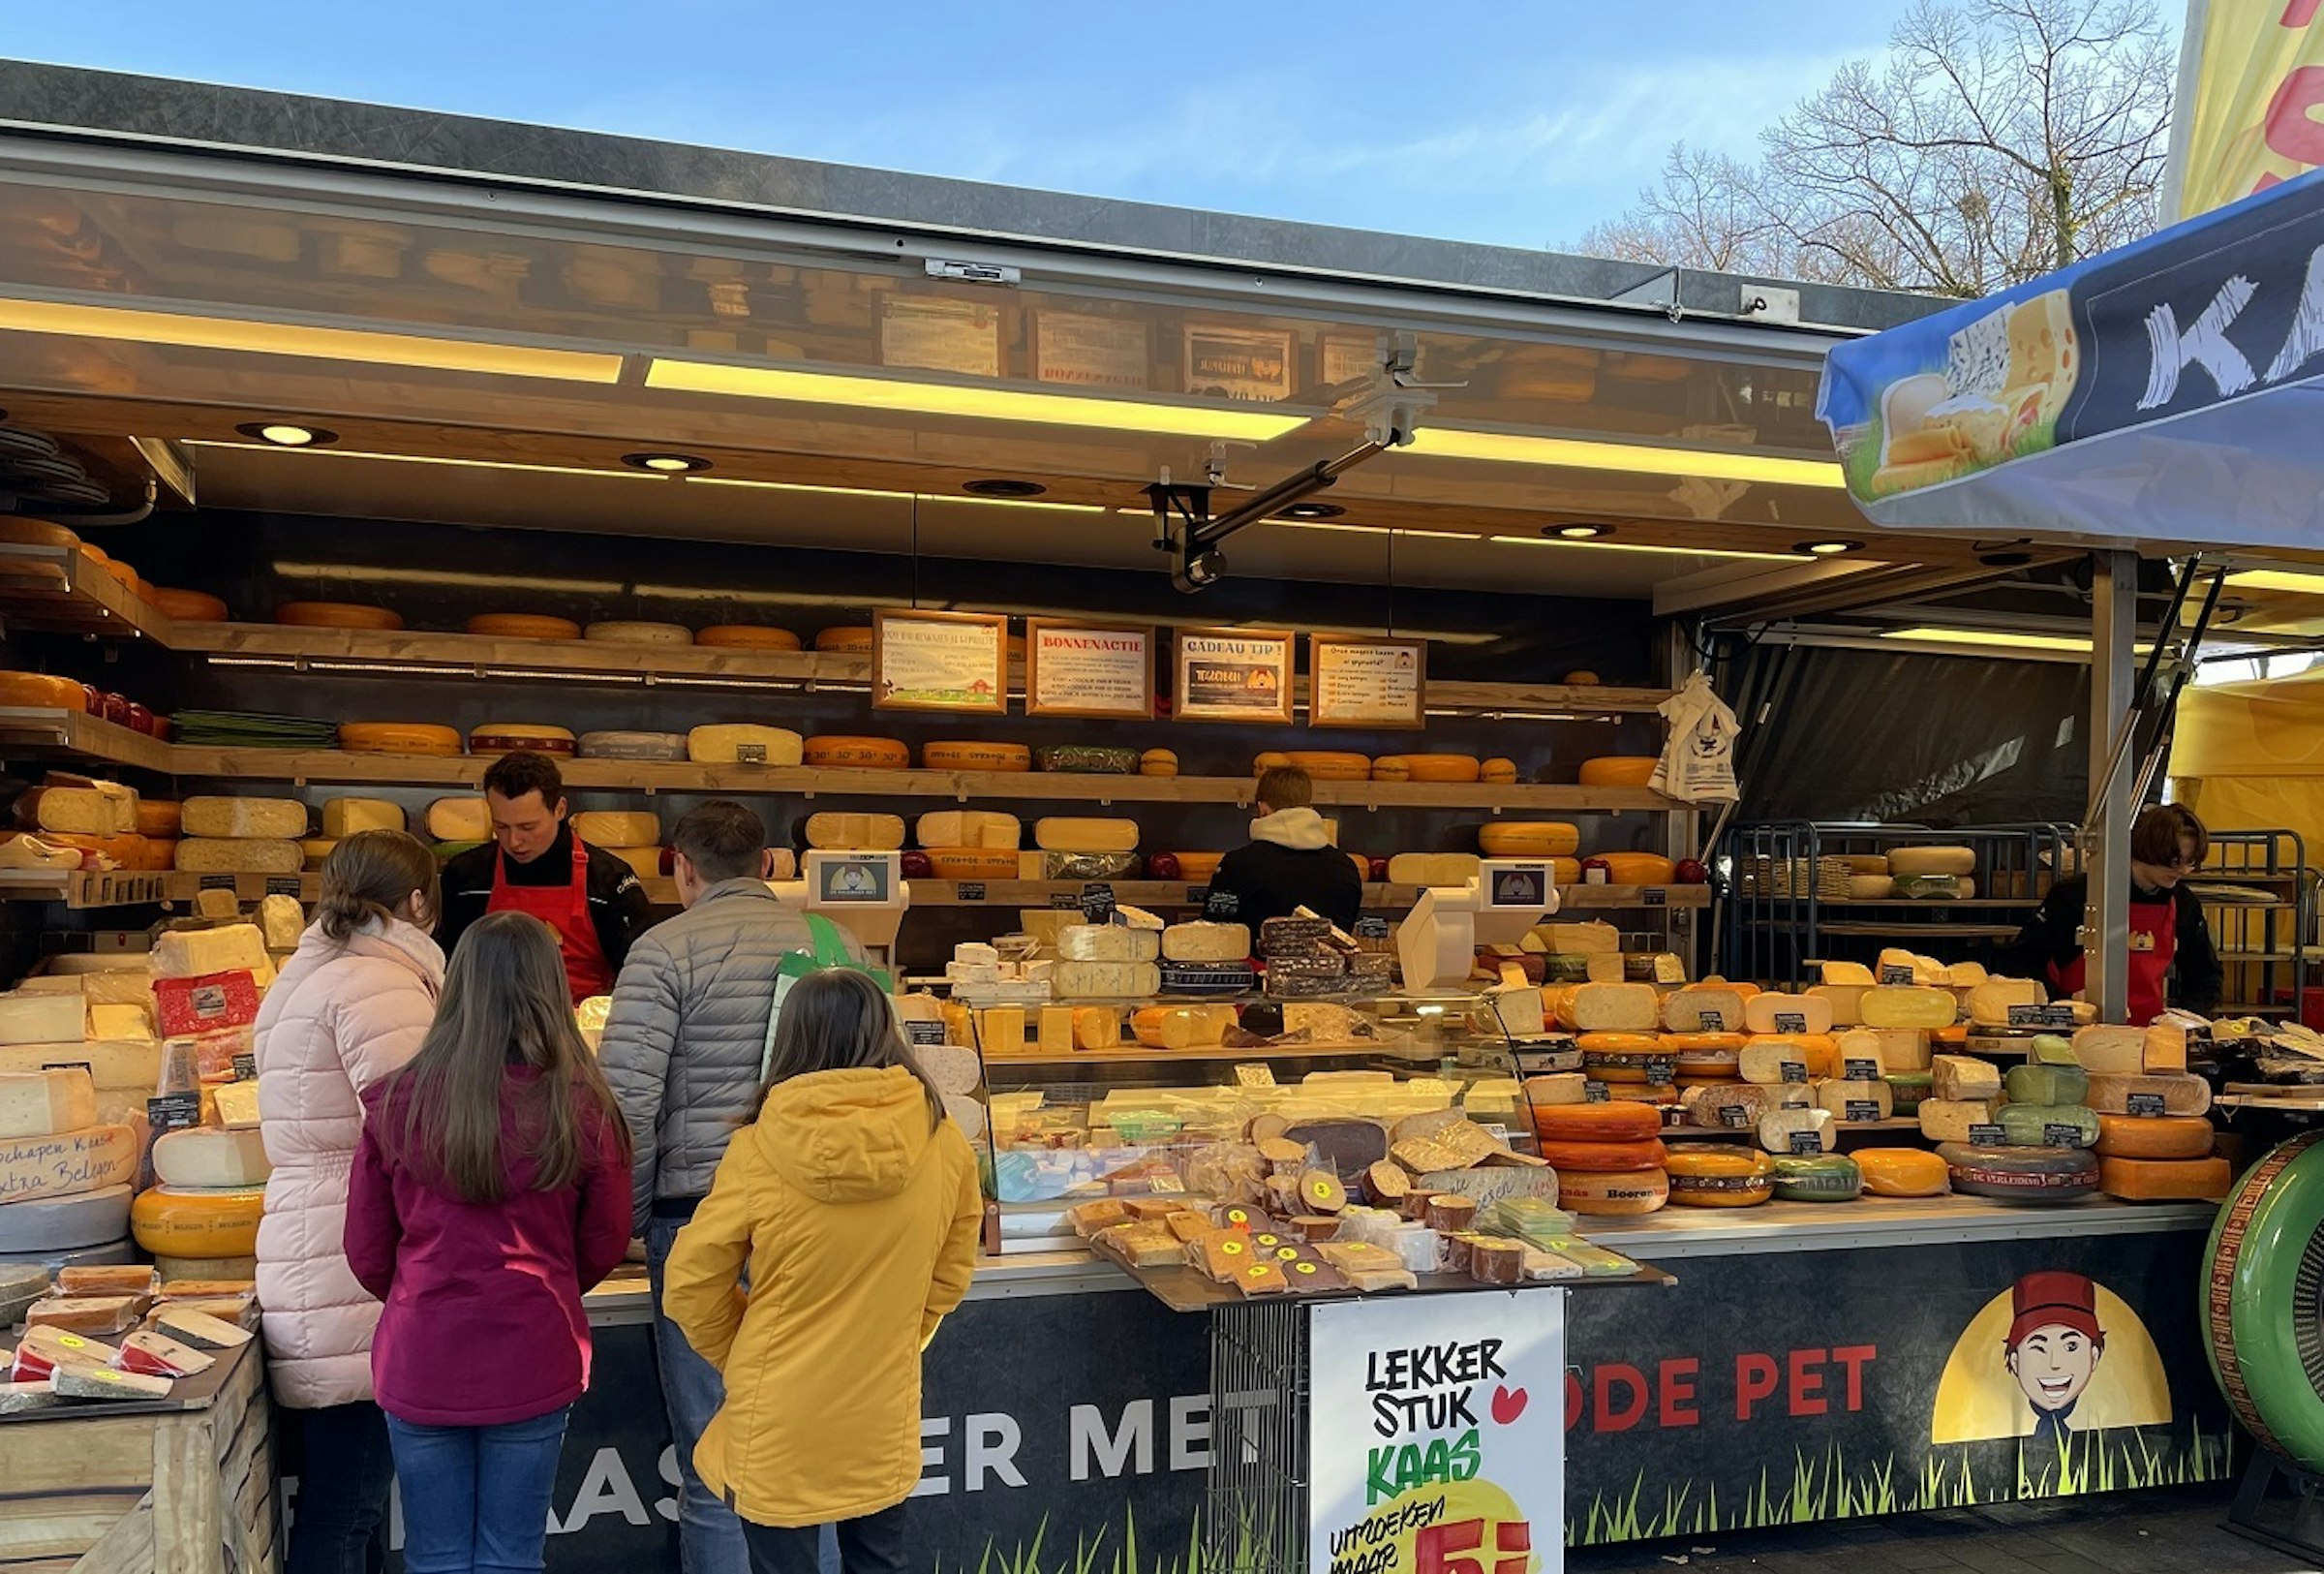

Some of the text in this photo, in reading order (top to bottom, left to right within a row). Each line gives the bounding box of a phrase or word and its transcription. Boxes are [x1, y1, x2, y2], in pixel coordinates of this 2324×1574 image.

[1044, 636, 1142, 652] BONNENACTIE
[1187, 640, 1245, 654] CADEAU
[1366, 1339, 1507, 1391] LEKKER
[1736, 1344, 1877, 1421] PET
[1069, 1388, 1276, 1481] MET
[1374, 1386, 1479, 1437] STUK
[1366, 1429, 1482, 1505] KAAS
